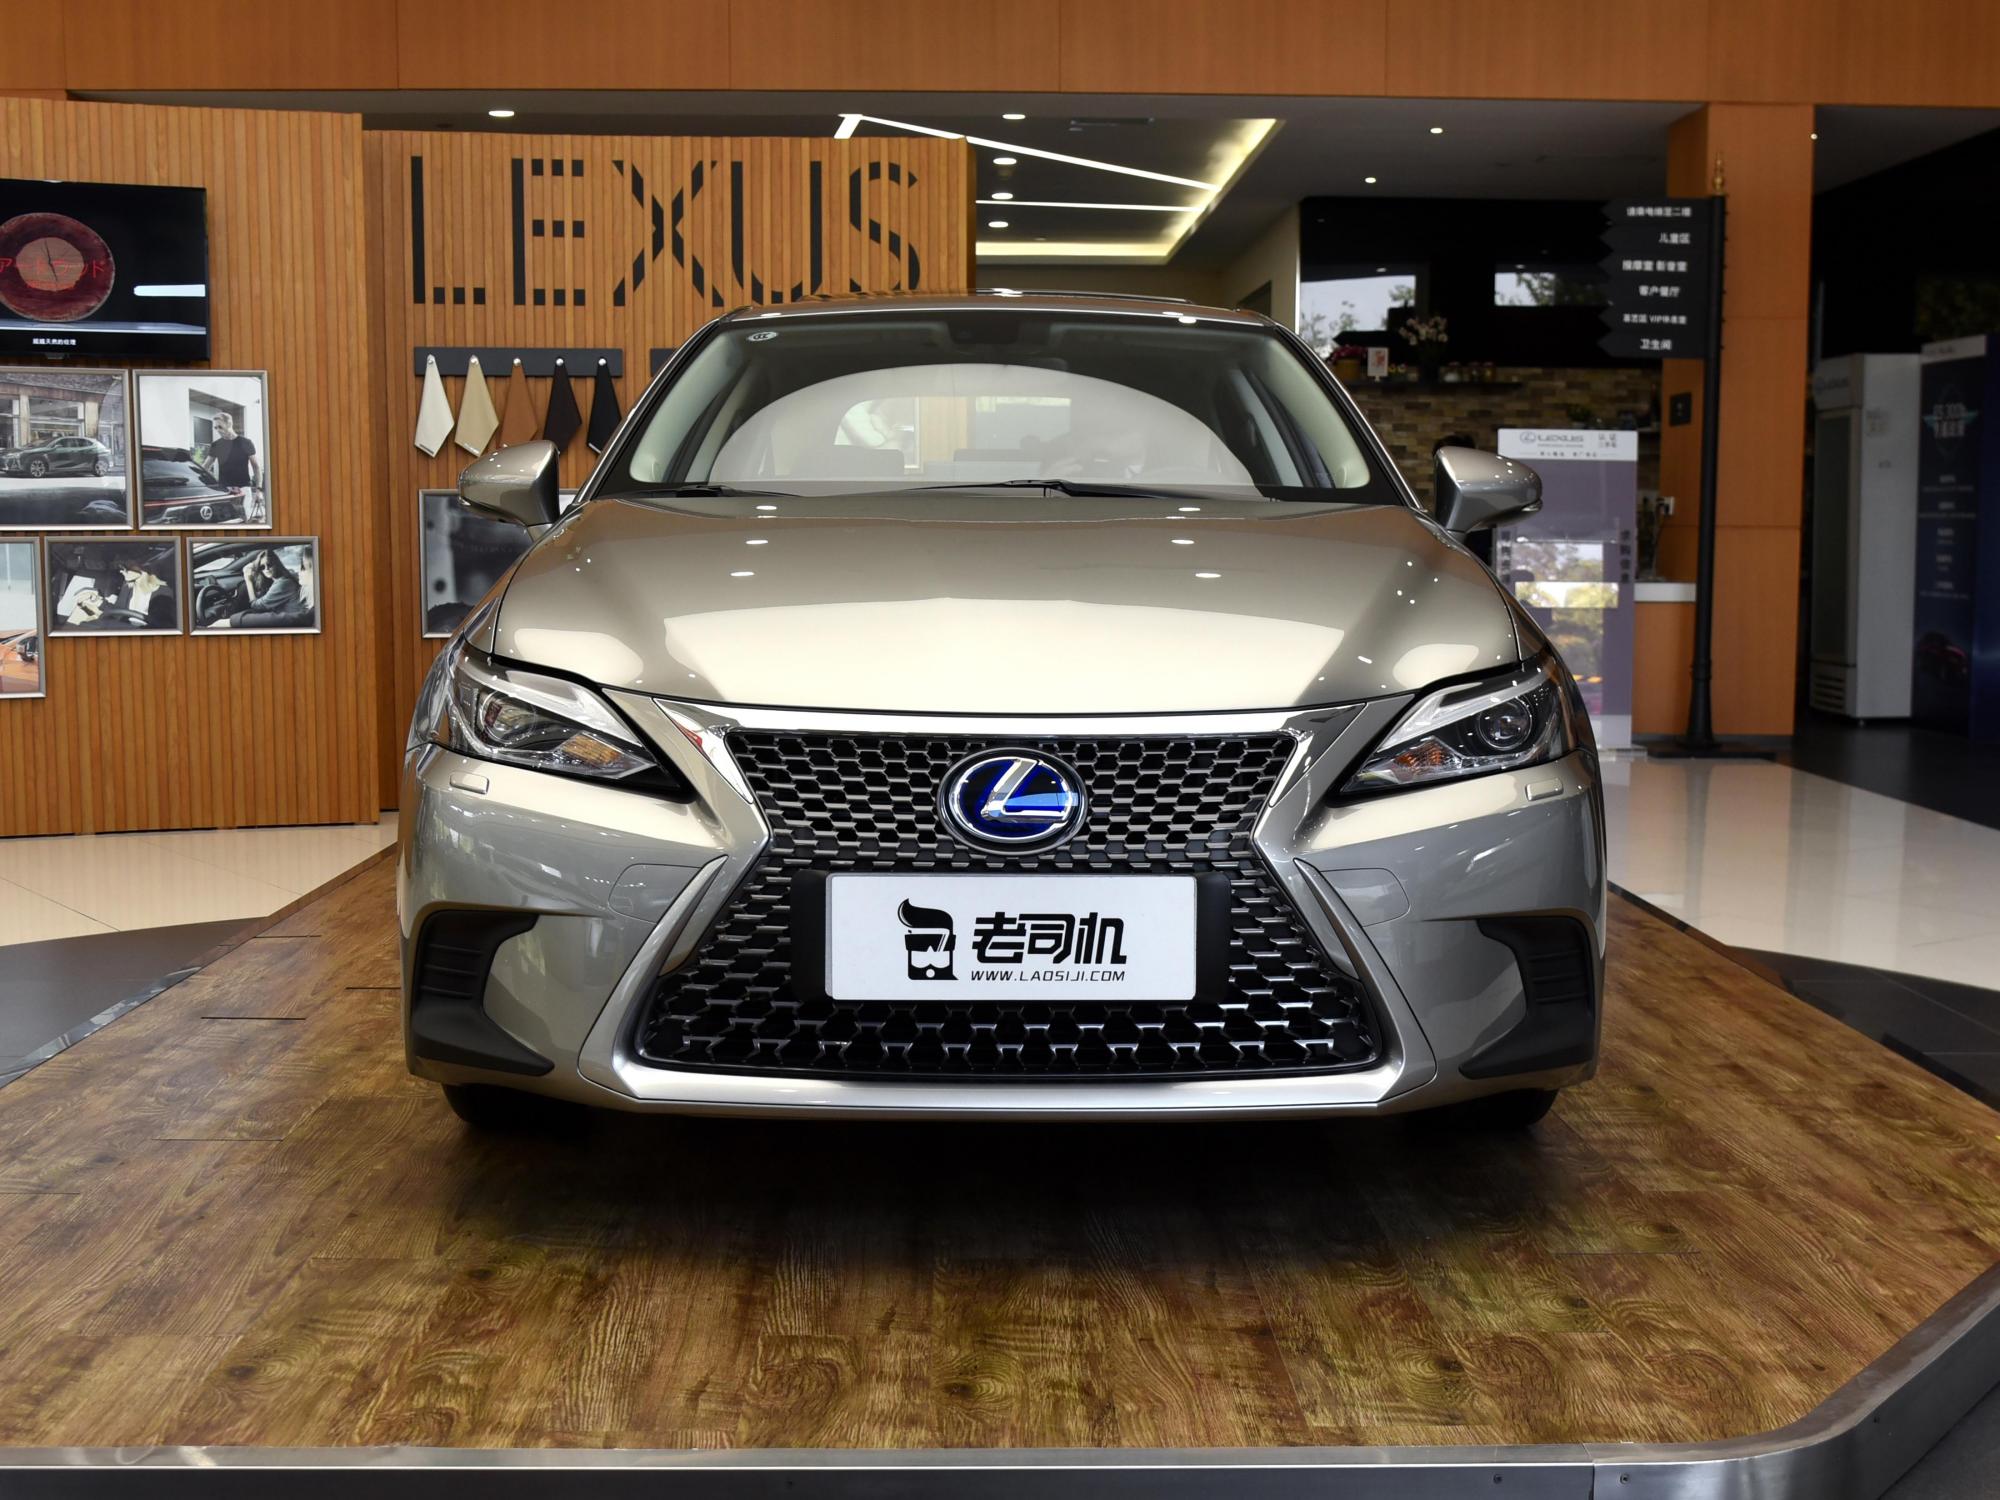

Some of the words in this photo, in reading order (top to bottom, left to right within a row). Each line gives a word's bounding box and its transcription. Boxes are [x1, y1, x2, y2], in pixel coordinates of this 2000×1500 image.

[411, 155, 920, 307] LEXUS
[971, 911, 1128, 965] 老司机
[970, 970, 1126, 982] WWW.LAOSIJI.COM
